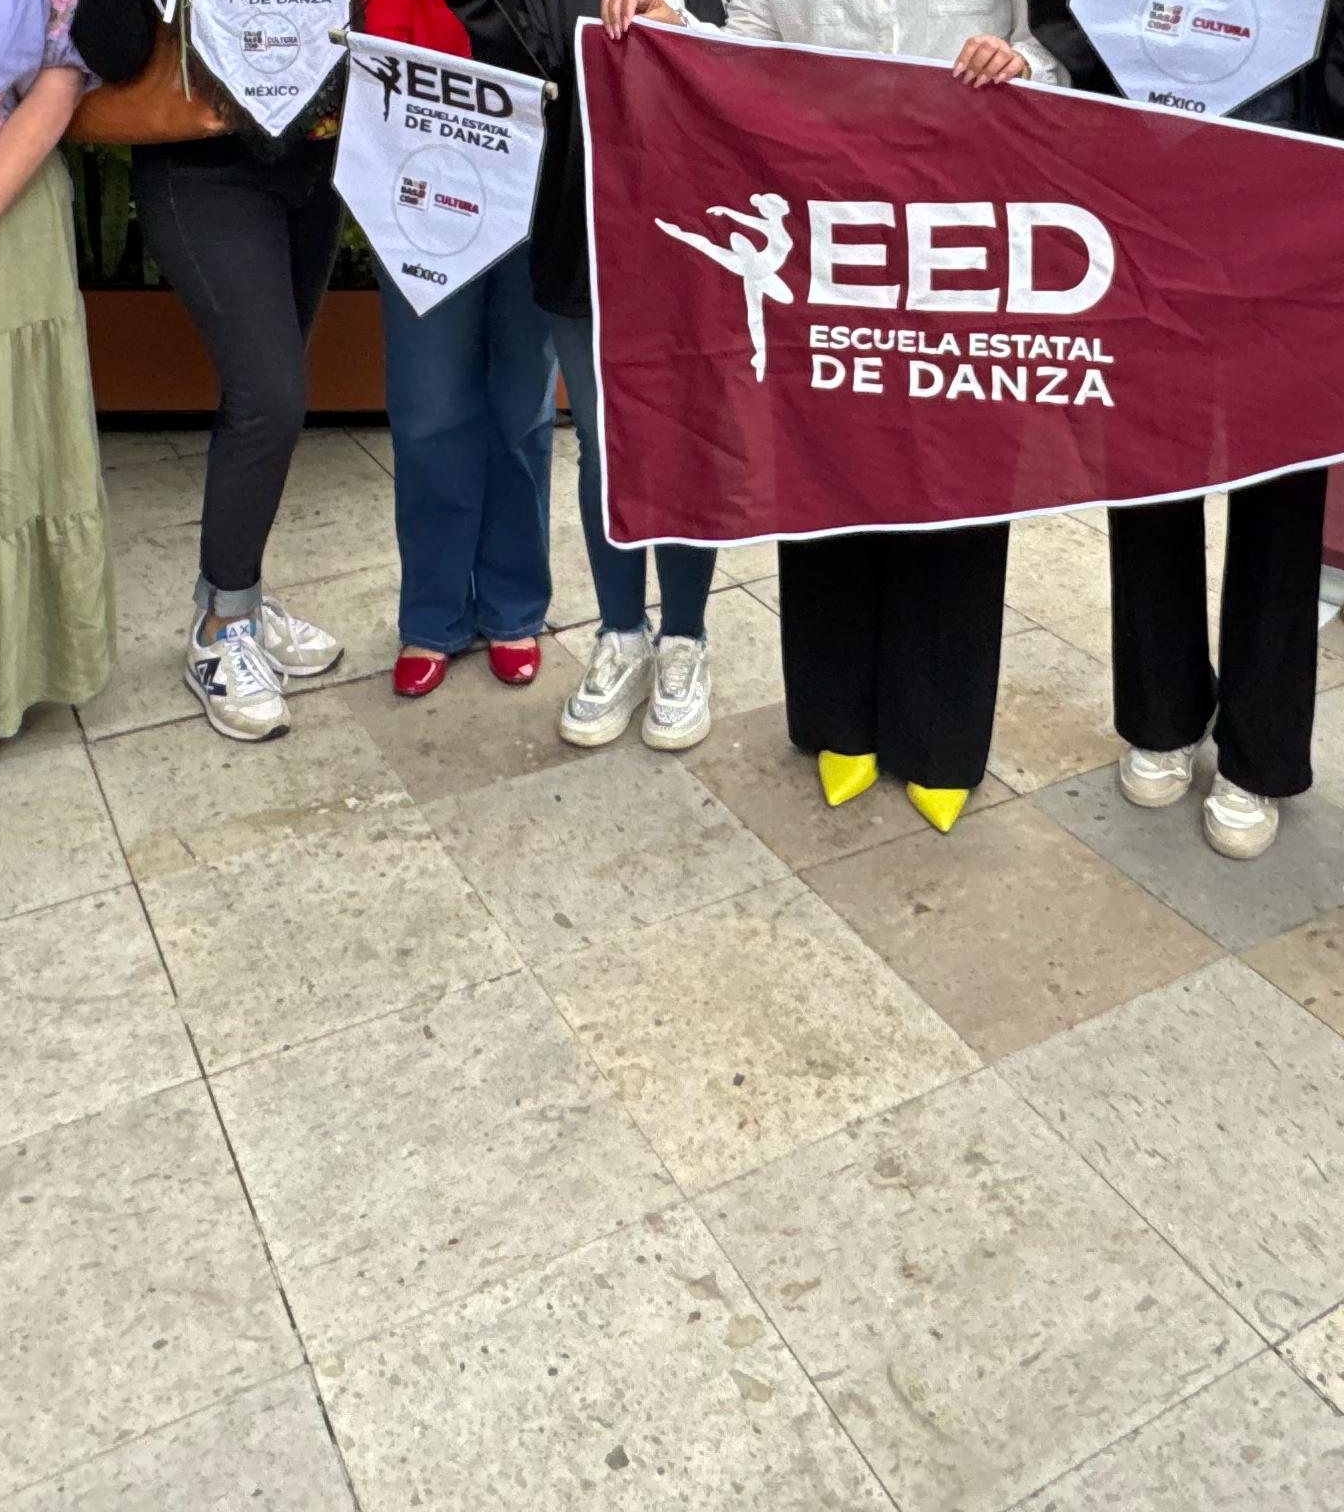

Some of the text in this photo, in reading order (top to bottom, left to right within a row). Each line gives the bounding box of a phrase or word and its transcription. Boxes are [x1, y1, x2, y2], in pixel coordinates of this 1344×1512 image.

[1192, 17, 1250, 38] CULTURA
[245, 85, 299, 97] MÉXICO
[406, 60, 513, 118] EED
[1148, 91, 1205, 113] MÉXICO
[405, 116, 509, 154] DE DANZA
[406, 104, 511, 138] ESCUELA ESTATAL
[435, 194, 479, 214] CULTURA
[401, 262, 447, 285] MÉXICO
[806, 199, 1115, 314] EED
[809, 325, 1114, 363] ESCUELA ESTATAL
[810, 355, 1115, 407] DE DANZA
